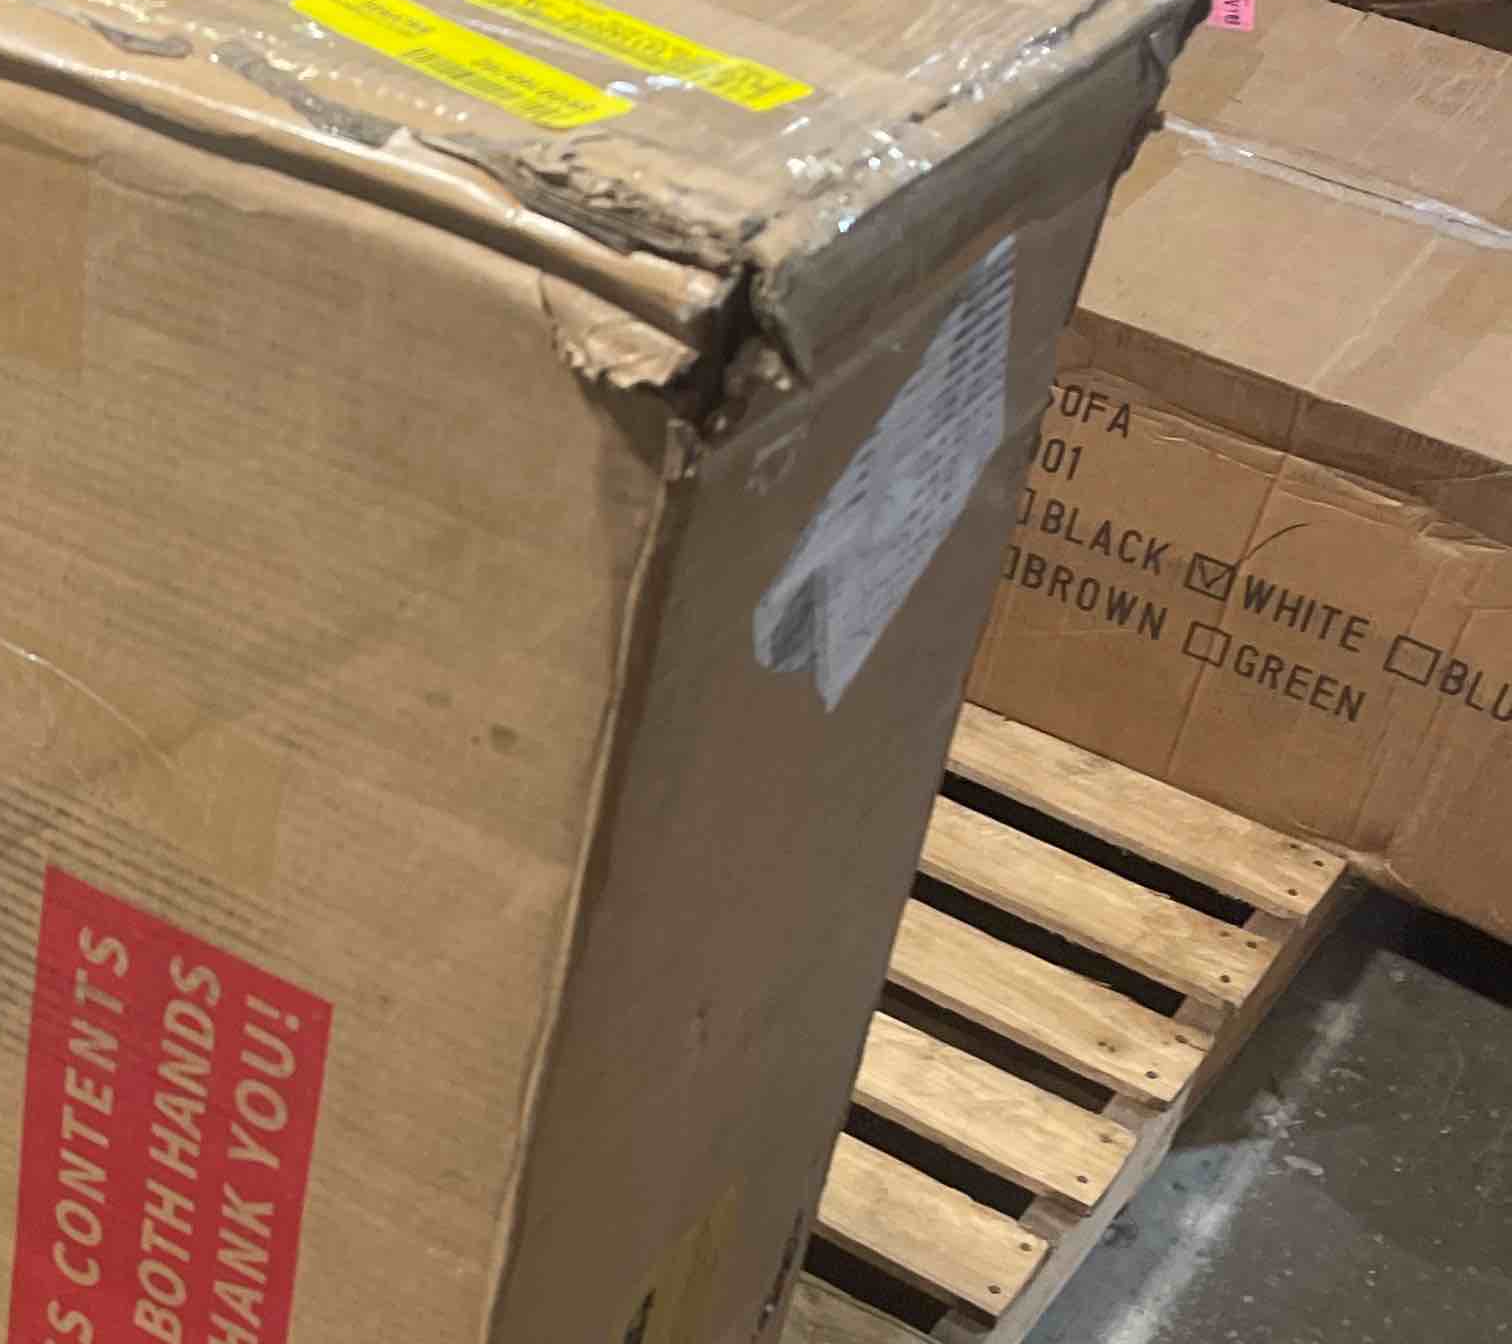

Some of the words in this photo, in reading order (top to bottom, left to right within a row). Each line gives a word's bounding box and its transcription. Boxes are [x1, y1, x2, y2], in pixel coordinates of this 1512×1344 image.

[1021, 552, 1169, 641] BROWN
[1232, 645, 1367, 723] GREEN
[1040, 499, 1170, 576] BLACK
[1244, 575, 1370, 654] WHITE
[51, 927, 130, 1288] CONTENTS
[147, 955, 222, 1188] HANDS
[227, 993, 301, 1171] YOU!
